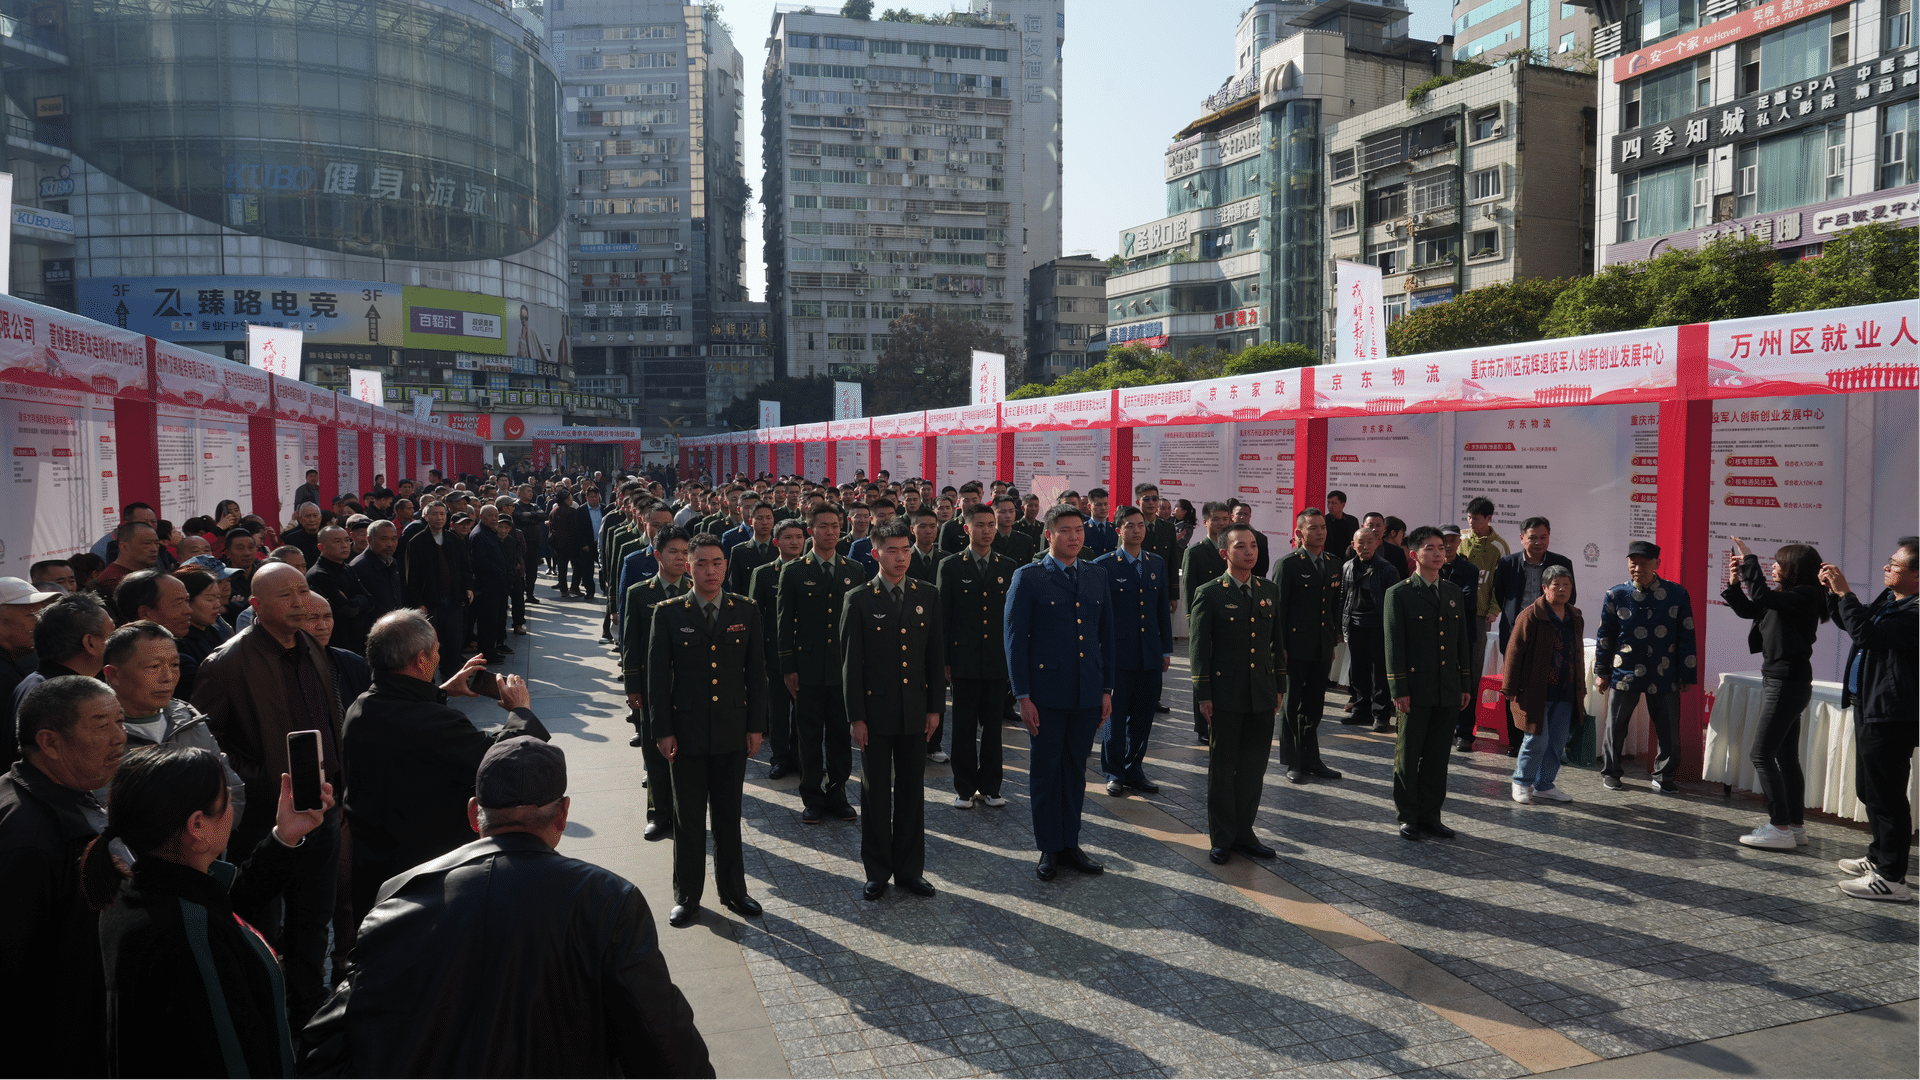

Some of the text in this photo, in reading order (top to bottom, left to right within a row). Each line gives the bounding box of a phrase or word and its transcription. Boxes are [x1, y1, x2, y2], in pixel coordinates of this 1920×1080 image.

[1024, 14, 1042, 103] 海友酒店
[1650, 25, 1742, 64] 安一个家 AnHaven
[1757, 93, 1836, 127] 私人影院
[1621, 106, 1746, 163] 四季知城
[228, 163, 315, 191] KUBO
[17, 212, 50, 227] KUBO
[1138, 217, 1187, 252] 圣悦口腔
[112, 285, 130, 297] 3F
[197, 289, 338, 319] 臻路电竞
[362, 289, 383, 302] 3F
[1729, 316, 1919, 360] 万州区就业人
[1209, 378, 1286, 401] 京东家政
[1331, 364, 1440, 391] 京东物流
[451, 421, 479, 430] SNACK
